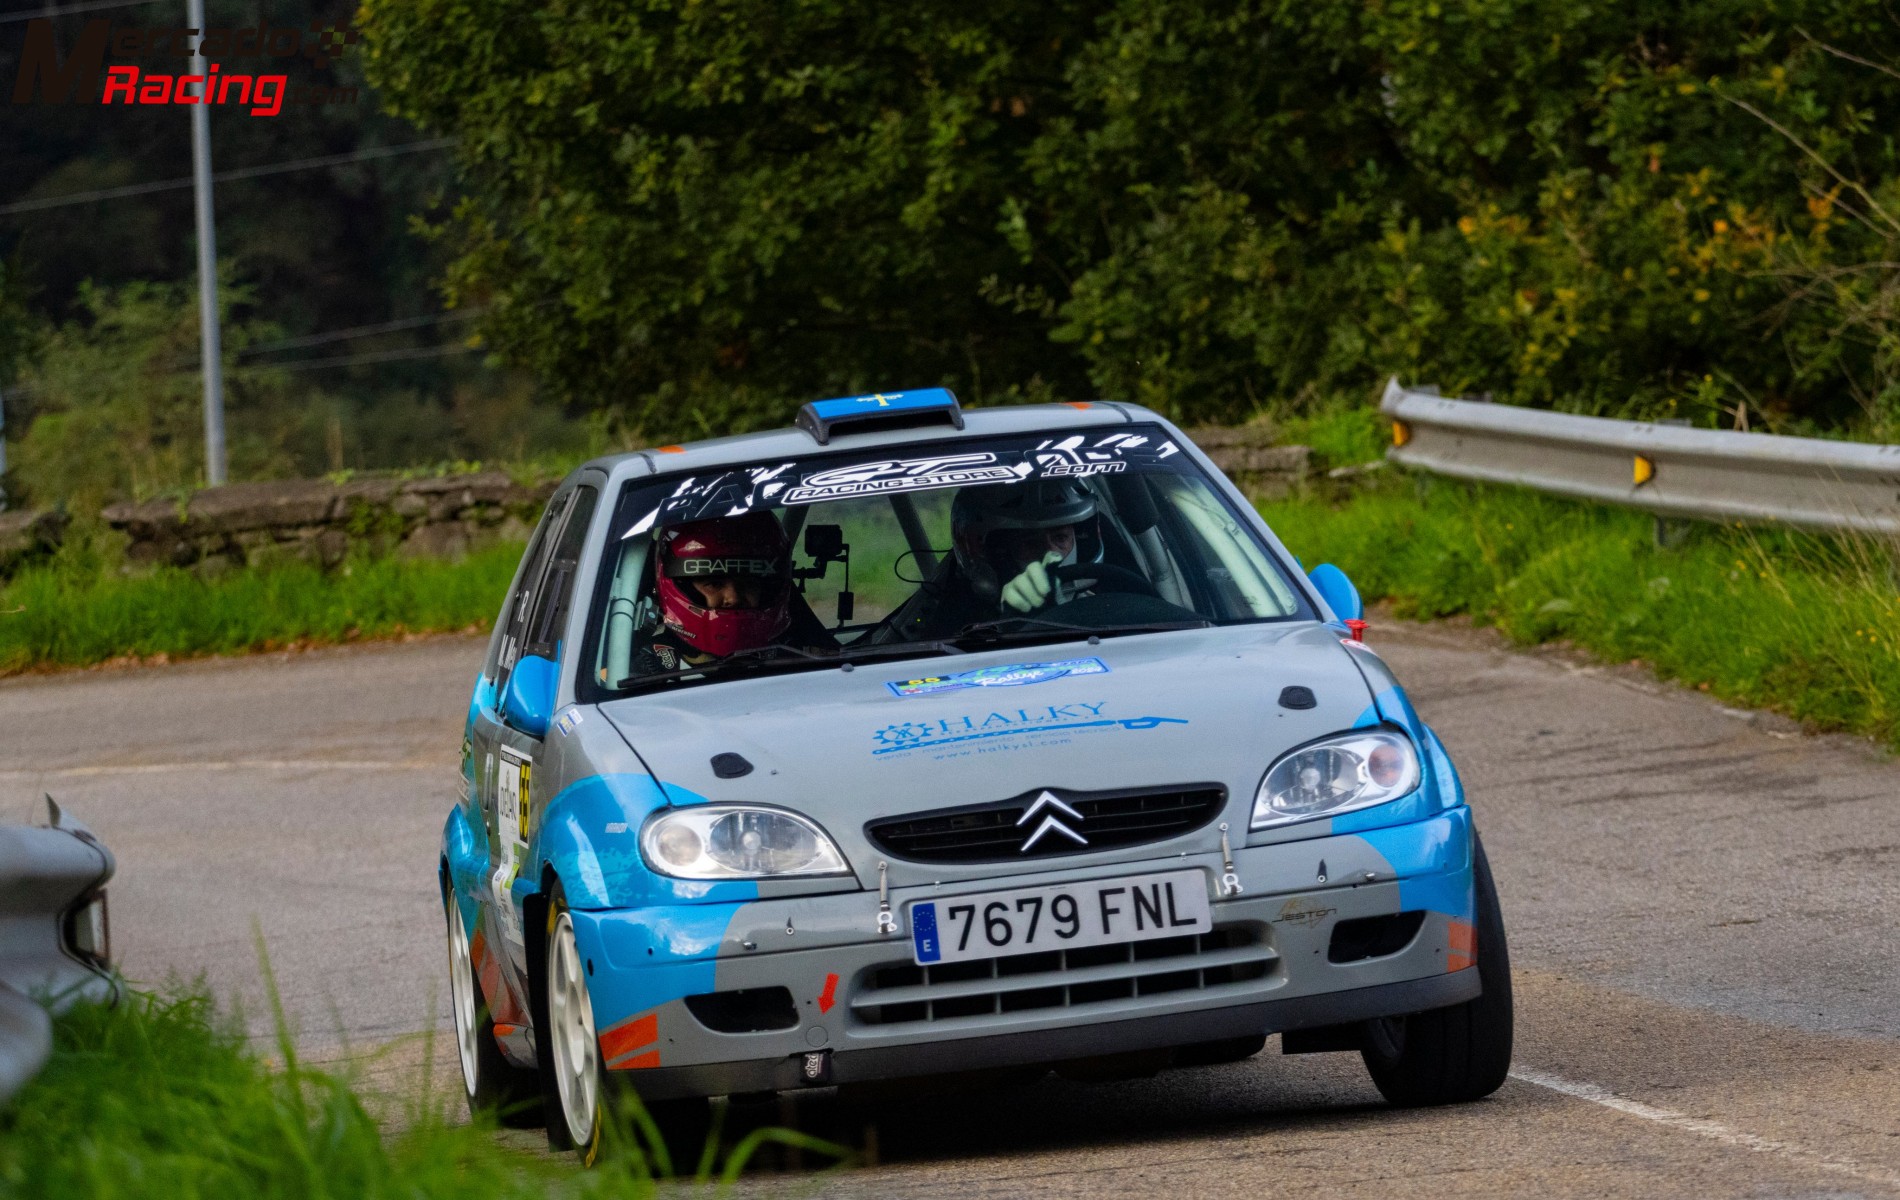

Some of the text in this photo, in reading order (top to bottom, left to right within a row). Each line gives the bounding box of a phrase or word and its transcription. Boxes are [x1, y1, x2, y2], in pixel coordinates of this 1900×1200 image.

[794, 468, 1010, 499] RACING-STORE
[1041, 461, 1127, 478] .com
[683, 557, 777, 576] GRAFFEX
[974, 671, 1044, 687] Rallye
[938, 702, 1109, 732] HALKY
[948, 881, 1198, 951] 7679 FNL
[923, 939, 932, 952] E
